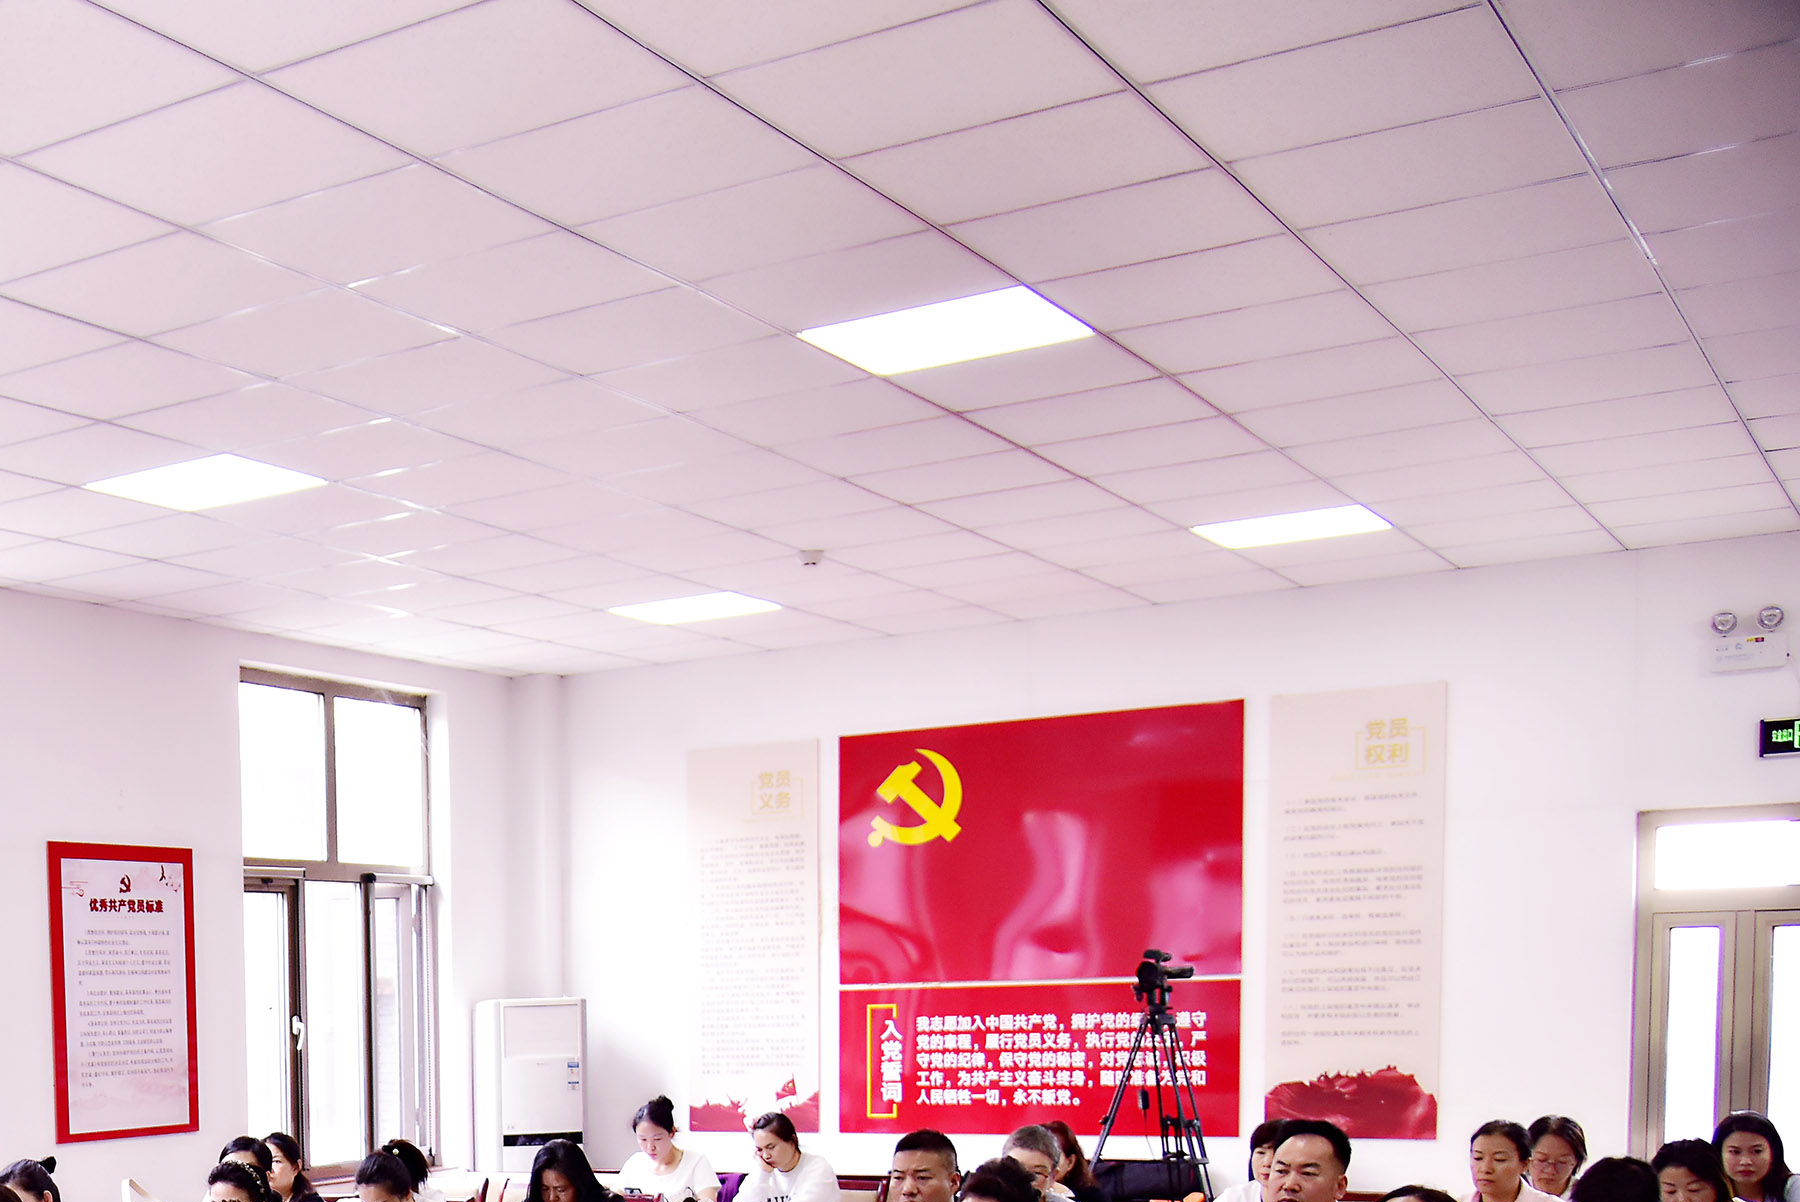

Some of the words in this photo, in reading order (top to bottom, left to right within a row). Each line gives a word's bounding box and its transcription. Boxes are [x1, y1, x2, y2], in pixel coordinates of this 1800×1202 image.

[89, 898, 163, 913] 优秀共产党员标准
[915, 1011, 1208, 1032] 我志愿加入中国共产党，拥护党的纲，遵守
[880, 1019, 903, 1103] 入党誓词
[915, 1088, 1082, 1107] 人民牺牲一切，永不叛党。
